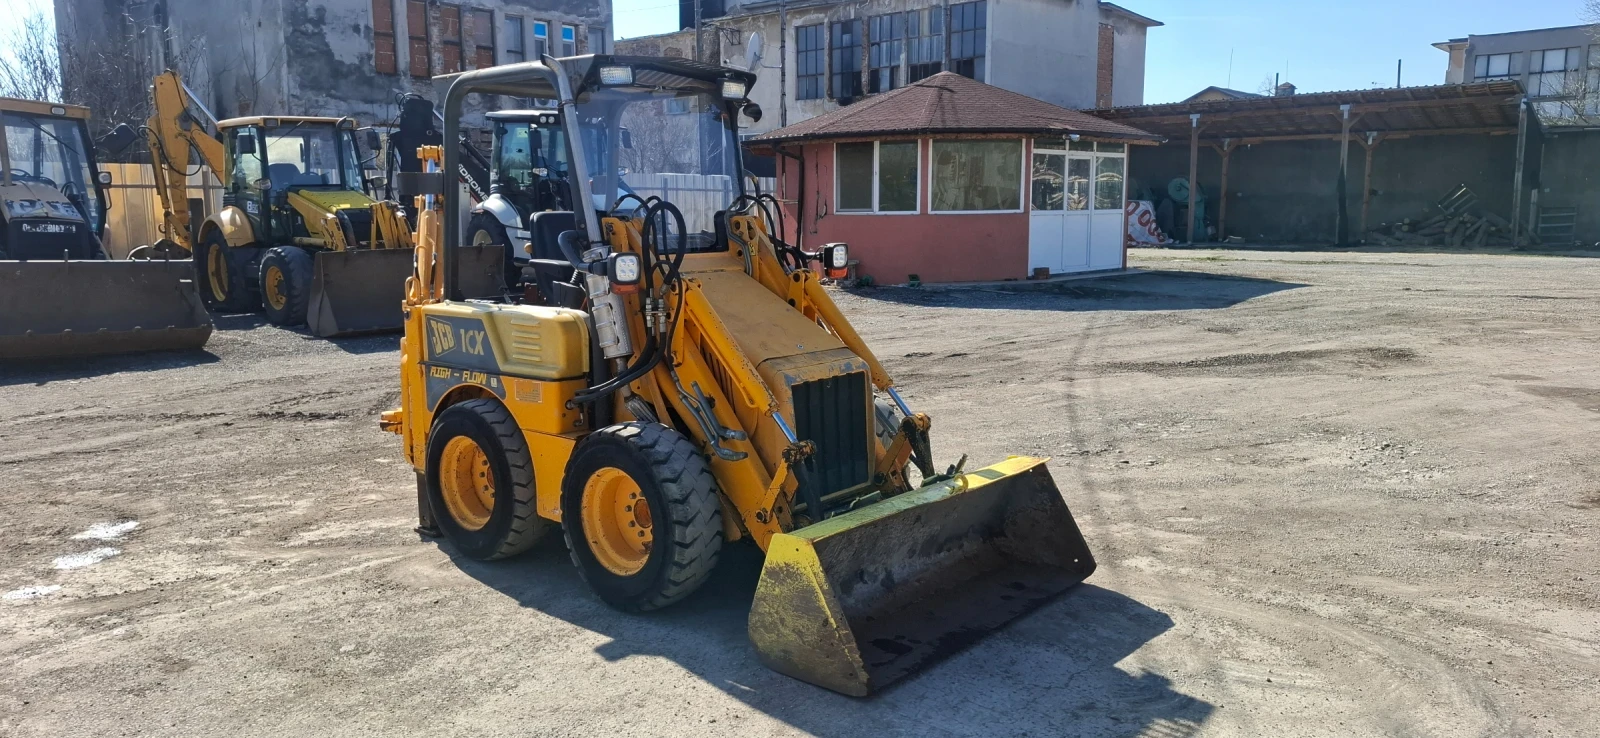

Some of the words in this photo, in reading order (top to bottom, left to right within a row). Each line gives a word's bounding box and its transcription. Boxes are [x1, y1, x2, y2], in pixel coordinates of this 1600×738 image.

[430, 319, 455, 354] JCB
[460, 328, 485, 355] 1CX
[430, 366, 451, 379] HIGH
[462, 370, 487, 385] FLOW
